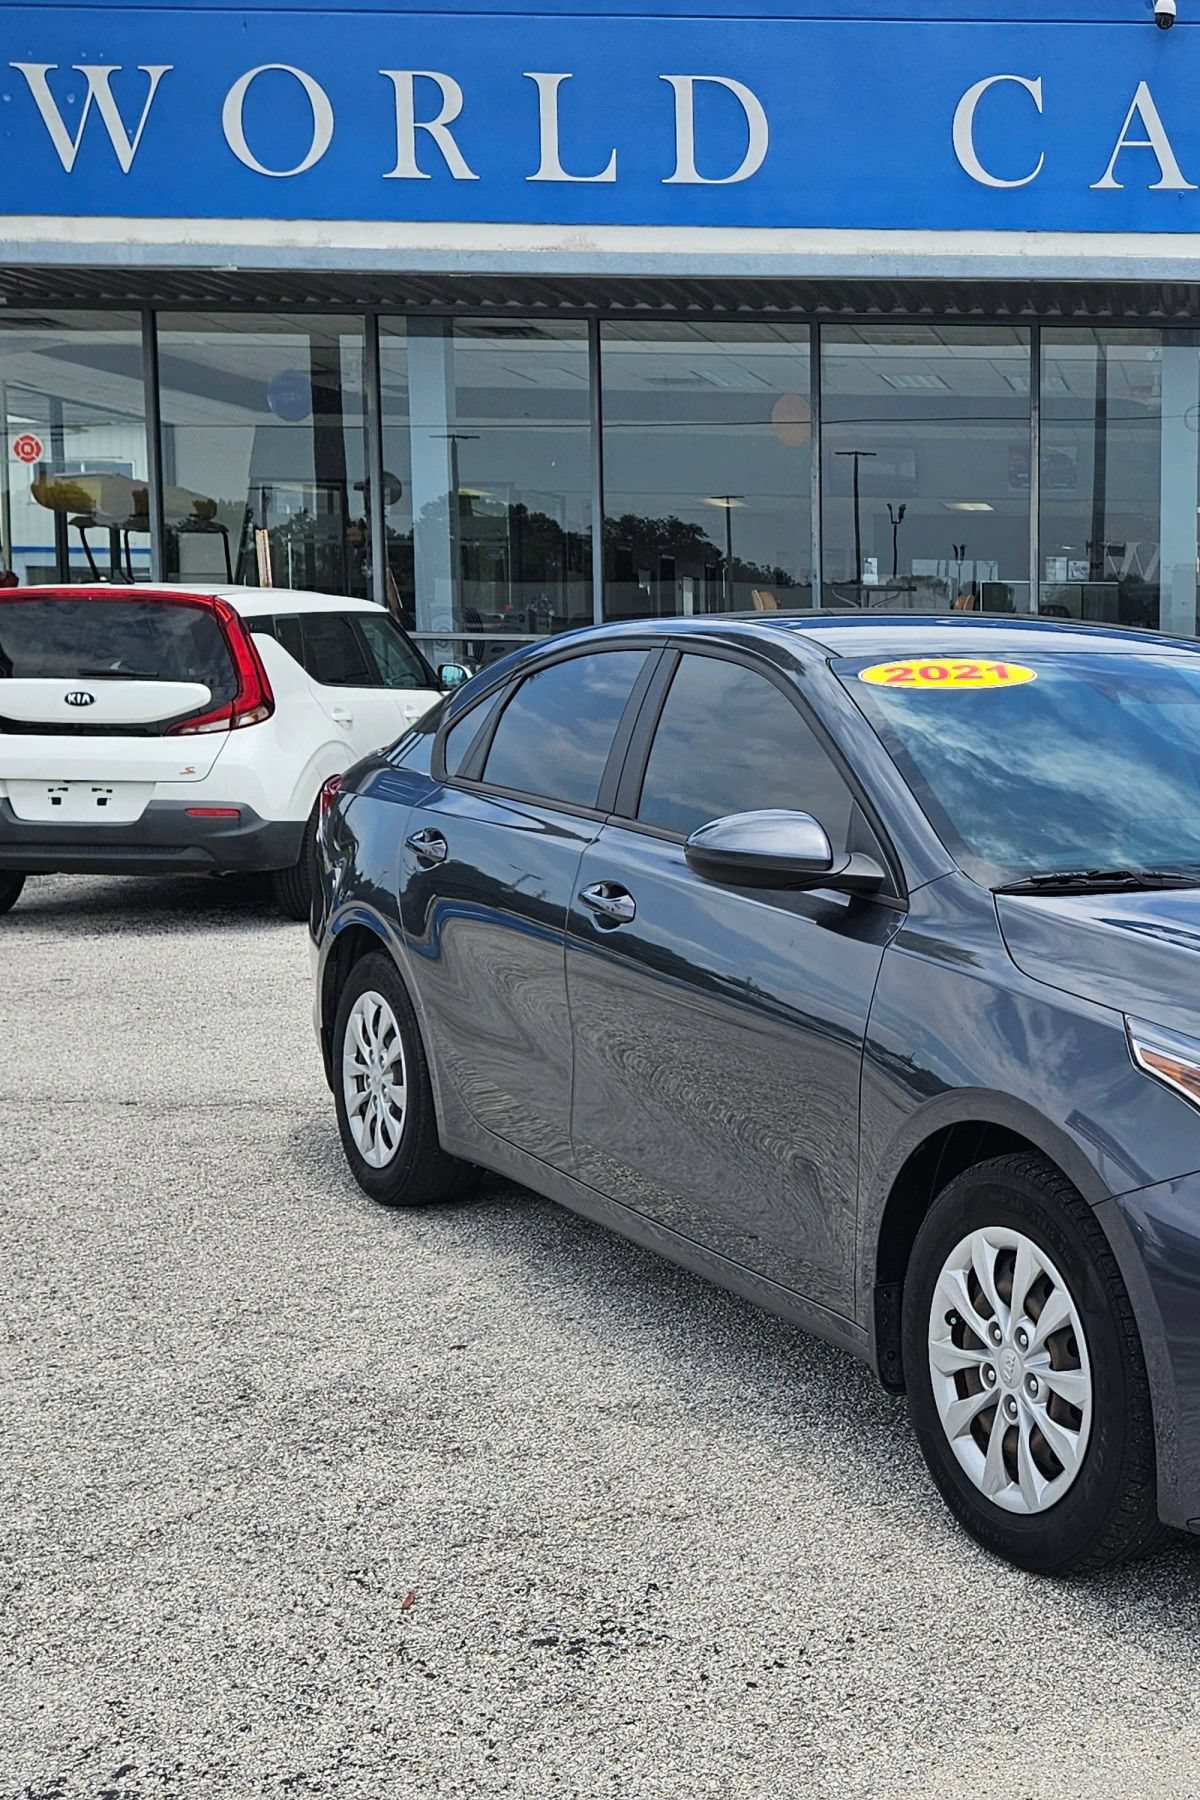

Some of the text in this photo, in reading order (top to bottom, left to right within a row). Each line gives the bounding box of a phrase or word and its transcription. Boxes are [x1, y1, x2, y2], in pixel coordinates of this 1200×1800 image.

[9, 62, 769, 184] WORLD
[884, 665, 1010, 683] 2021
[66, 693, 92, 705] KIA
